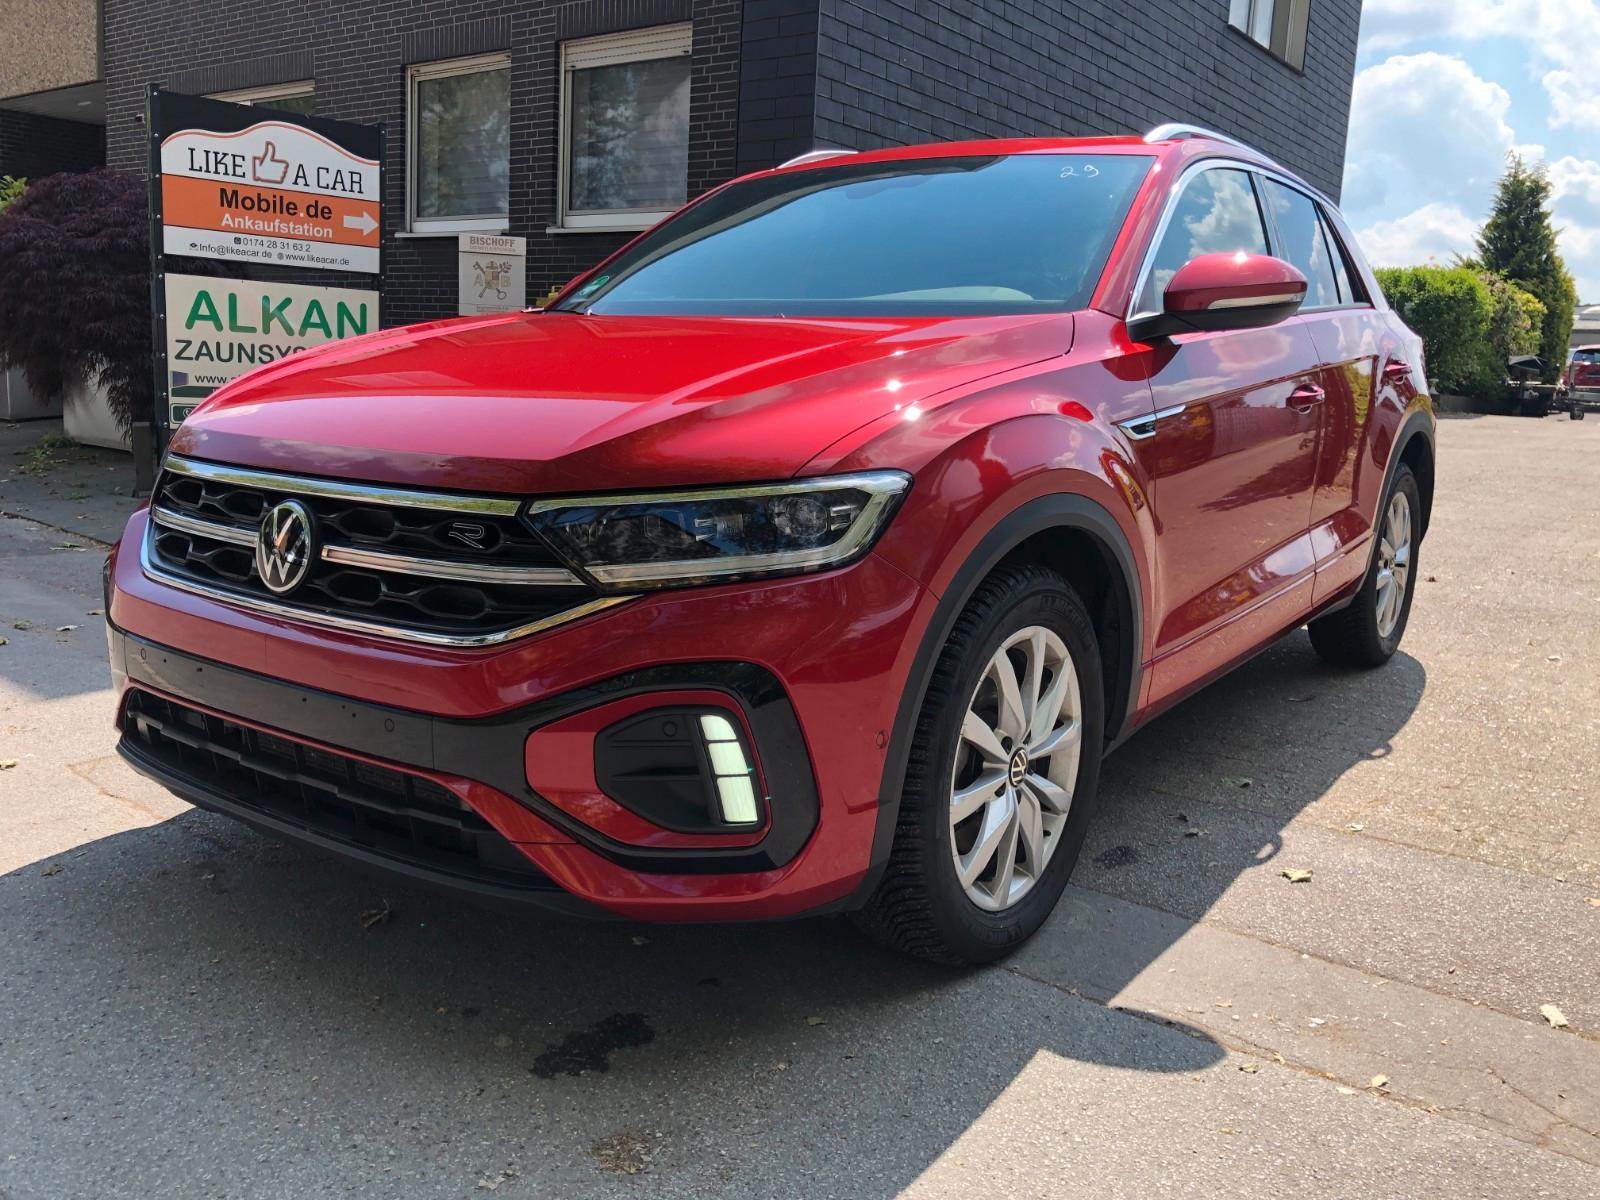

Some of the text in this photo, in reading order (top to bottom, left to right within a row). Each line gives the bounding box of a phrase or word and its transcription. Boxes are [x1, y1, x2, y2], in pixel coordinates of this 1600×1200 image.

[188, 148, 364, 194] LIKE A CAR
[219, 187, 333, 220] Mobile.de
[221, 212, 333, 238] Ankaufstation
[242, 237, 312, 253] 0174 28 31 63 2
[470, 236, 516, 247] BISCHOFF
[285, 252, 350, 266] www.likeacar.de
[185, 290, 367, 339] ALKAN
